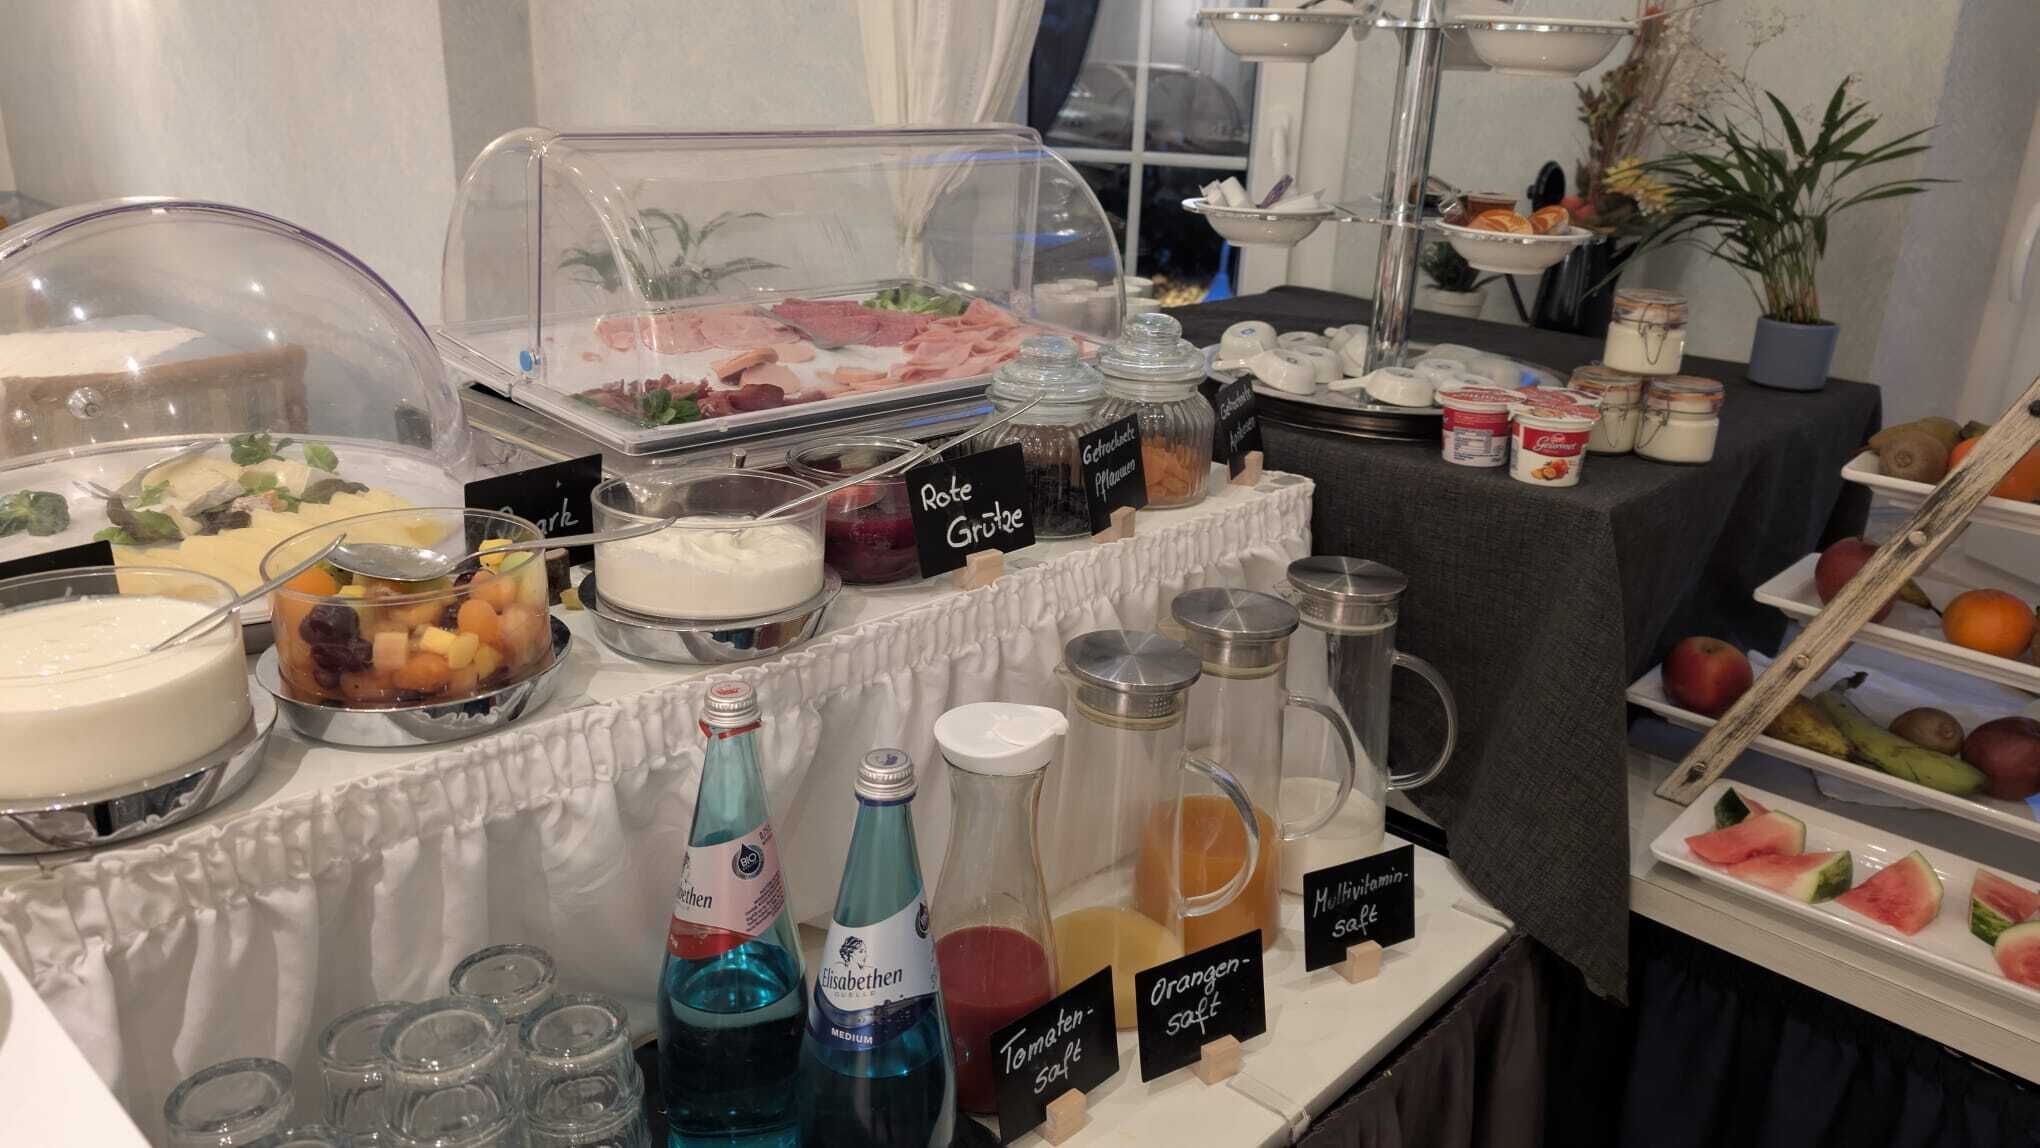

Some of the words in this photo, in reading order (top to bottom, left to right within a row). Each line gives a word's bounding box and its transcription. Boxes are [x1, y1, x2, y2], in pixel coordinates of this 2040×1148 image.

[921, 475, 973, 511] Rote
[947, 501, 1024, 548] Grütze
[1313, 866, 1409, 918] Multivitamin-
[822, 967, 903, 991] Elisabethen
[1151, 958, 1250, 1006] Orangen-
[831, 1027, 873, 1045] MEDIUM
[1000, 1008, 1094, 1074] Tomaten-
